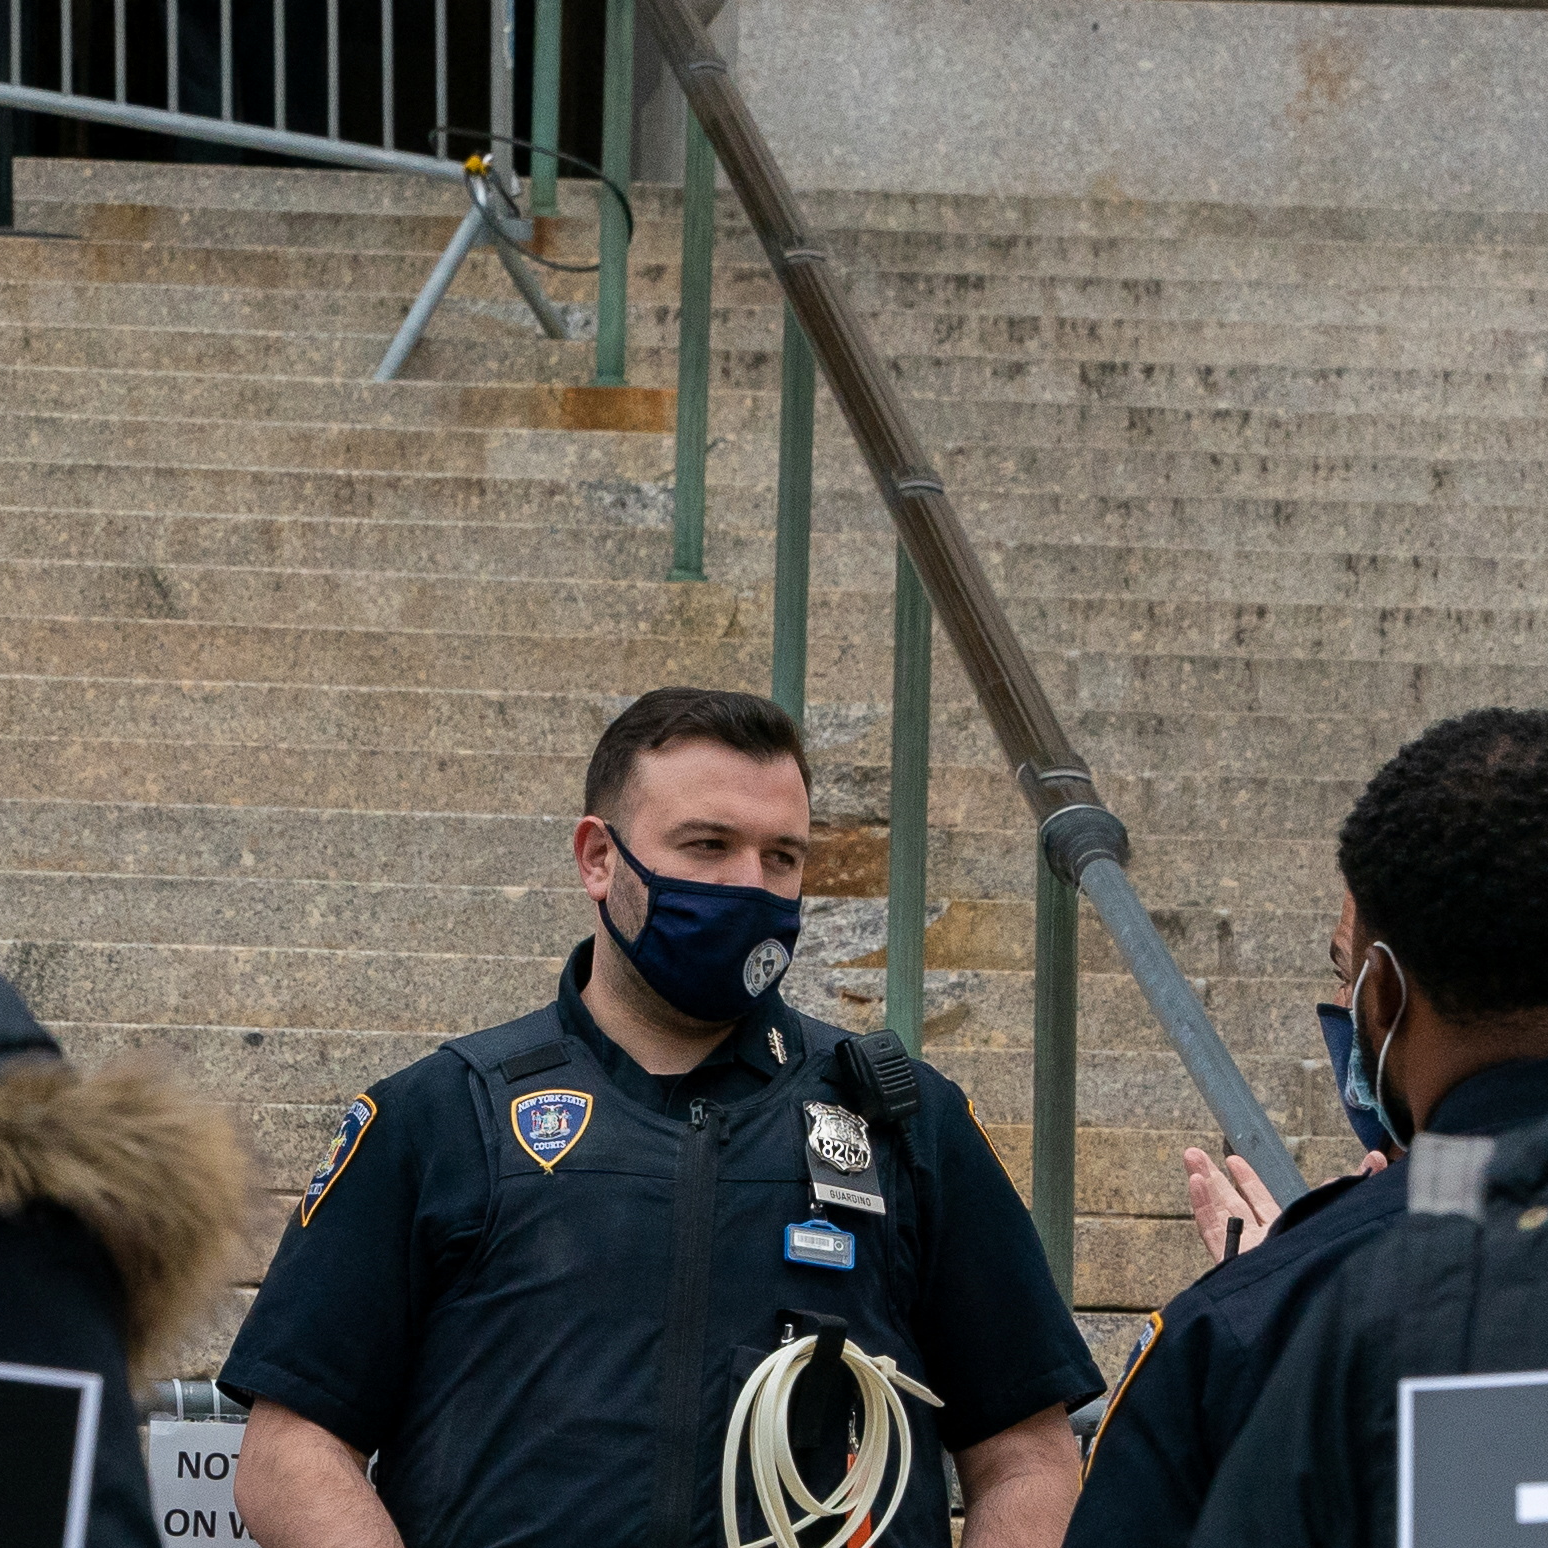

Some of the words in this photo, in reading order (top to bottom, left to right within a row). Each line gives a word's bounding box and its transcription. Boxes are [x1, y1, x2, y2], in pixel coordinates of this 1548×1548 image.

[517, 1097, 538, 1113] NEW
[538, 1094, 562, 1104] YORK
[562, 1094, 587, 1108] STATE
[533, 1139, 567, 1151] COURTS
[178, 1451, 239, 1480] NO
[163, 1509, 217, 1538] ON
